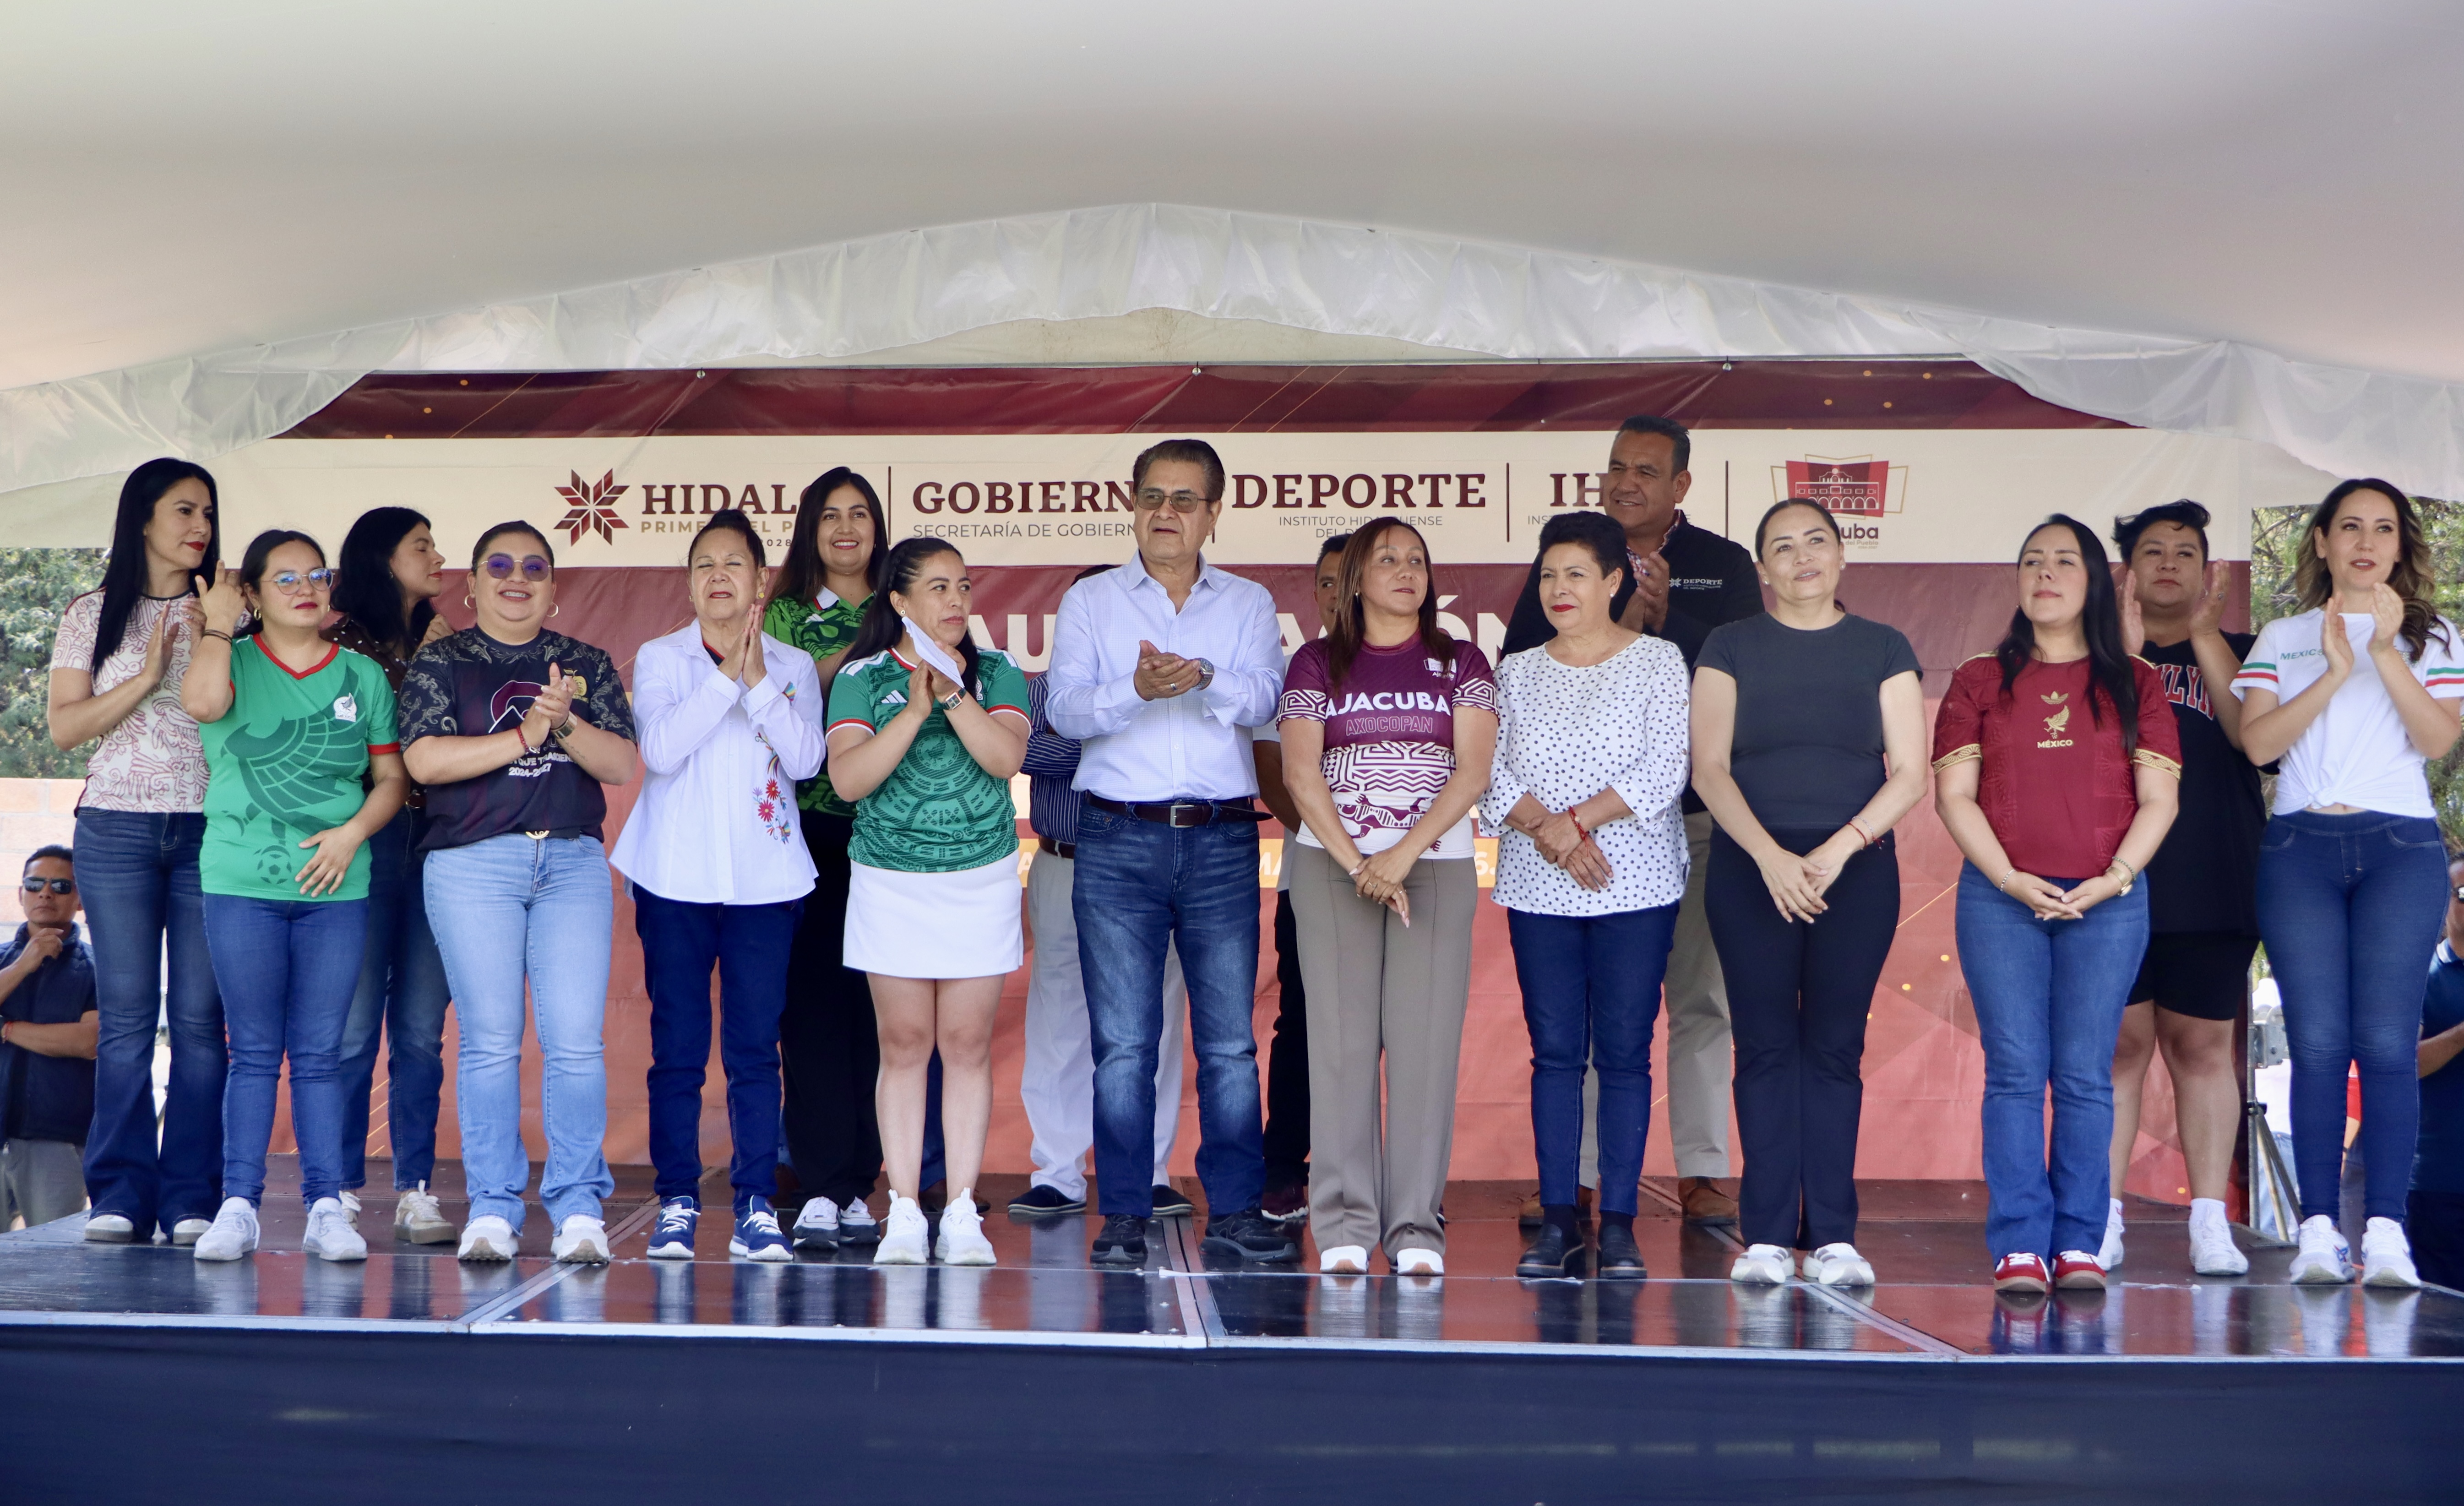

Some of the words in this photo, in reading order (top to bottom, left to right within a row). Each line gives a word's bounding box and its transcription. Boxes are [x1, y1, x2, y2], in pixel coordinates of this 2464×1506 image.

[642, 484, 810, 515] HIDAL
[913, 481, 1134, 514] GOBIERN
[1231, 473, 1486, 508] DEPORTE
[1550, 473, 1608, 506] IH
[641, 521, 706, 533] PRIME
[913, 521, 1022, 537] SECRETARÍA
[1028, 524, 1051, 537] DE
[1057, 523, 1135, 536] GOBIERN
[1279, 516, 1346, 526] INSTITUTO
[1350, 516, 1443, 526] HIDUENSE
[1325, 692, 1451, 719] AJACUBA
[1346, 716, 1433, 736] AXOCOPAN
[2037, 739, 2073, 748] MÉXICO
